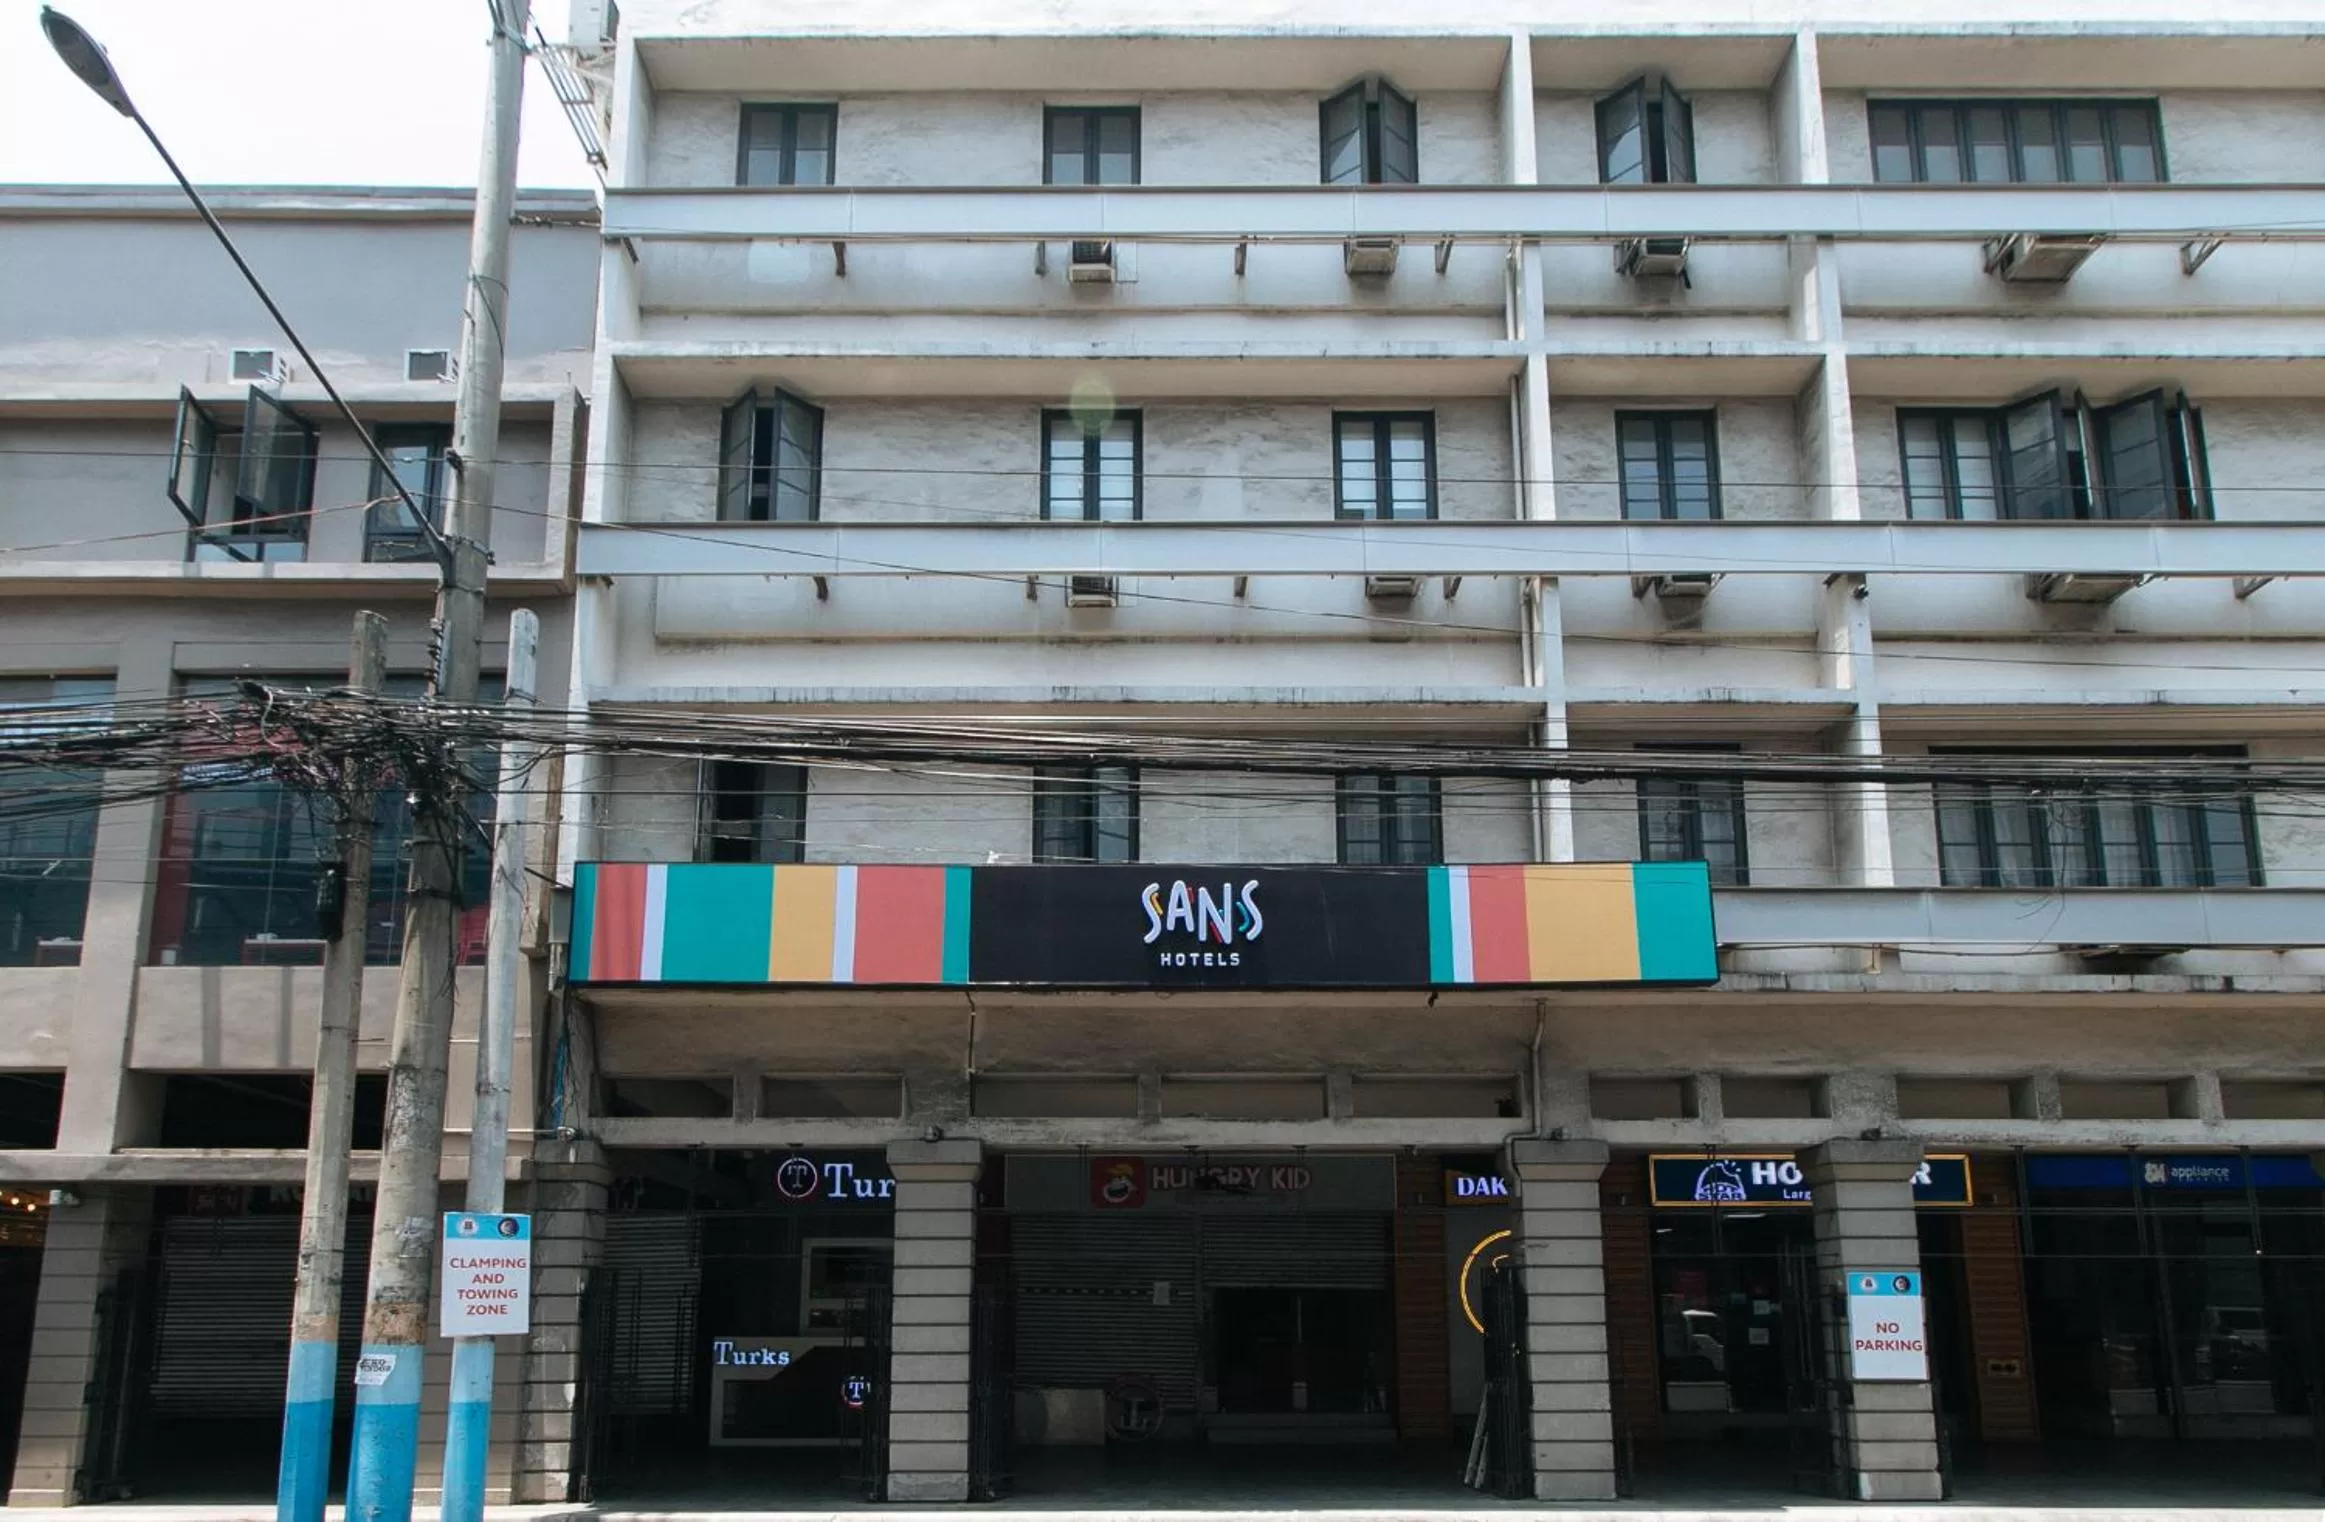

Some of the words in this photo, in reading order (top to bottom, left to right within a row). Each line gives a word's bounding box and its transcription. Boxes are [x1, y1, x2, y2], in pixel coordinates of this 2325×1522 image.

[1142, 880, 1263, 945] SANS
[1160, 953, 1241, 966] HOTELS
[1271, 1165, 1312, 1190] KID
[449, 1257, 527, 1269] CLAMPING
[471, 1273, 505, 1284] AND
[457, 1289, 519, 1300] TOWING
[466, 1304, 508, 1315] ZONE
[1876, 1322, 1900, 1334] NO
[1855, 1340, 1923, 1351] PARKING
[713, 1341, 791, 1366] Turks
